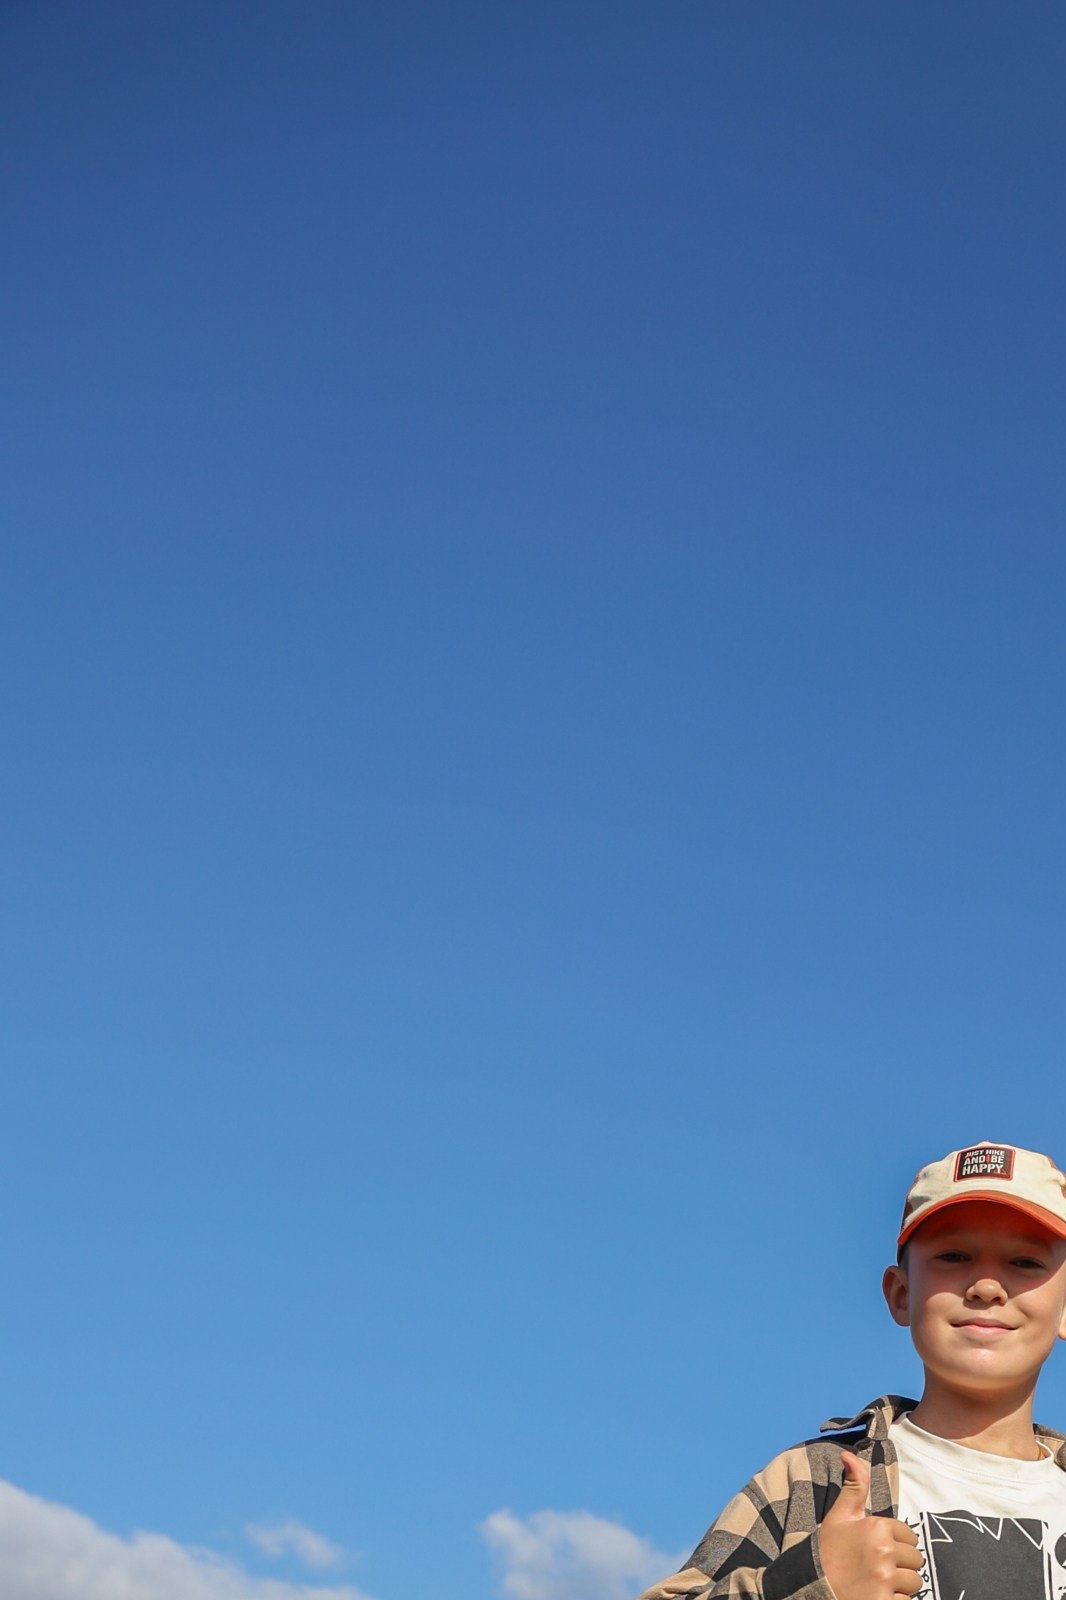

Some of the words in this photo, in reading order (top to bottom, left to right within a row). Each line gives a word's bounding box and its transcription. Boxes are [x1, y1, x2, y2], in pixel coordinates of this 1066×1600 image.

[963, 1155, 986, 1166] AND
[990, 1154, 1005, 1164] BE
[964, 1150, 985, 1159] JUST
[985, 1149, 1006, 1157] HIKE
[961, 1163, 1005, 1176] HAPPY
